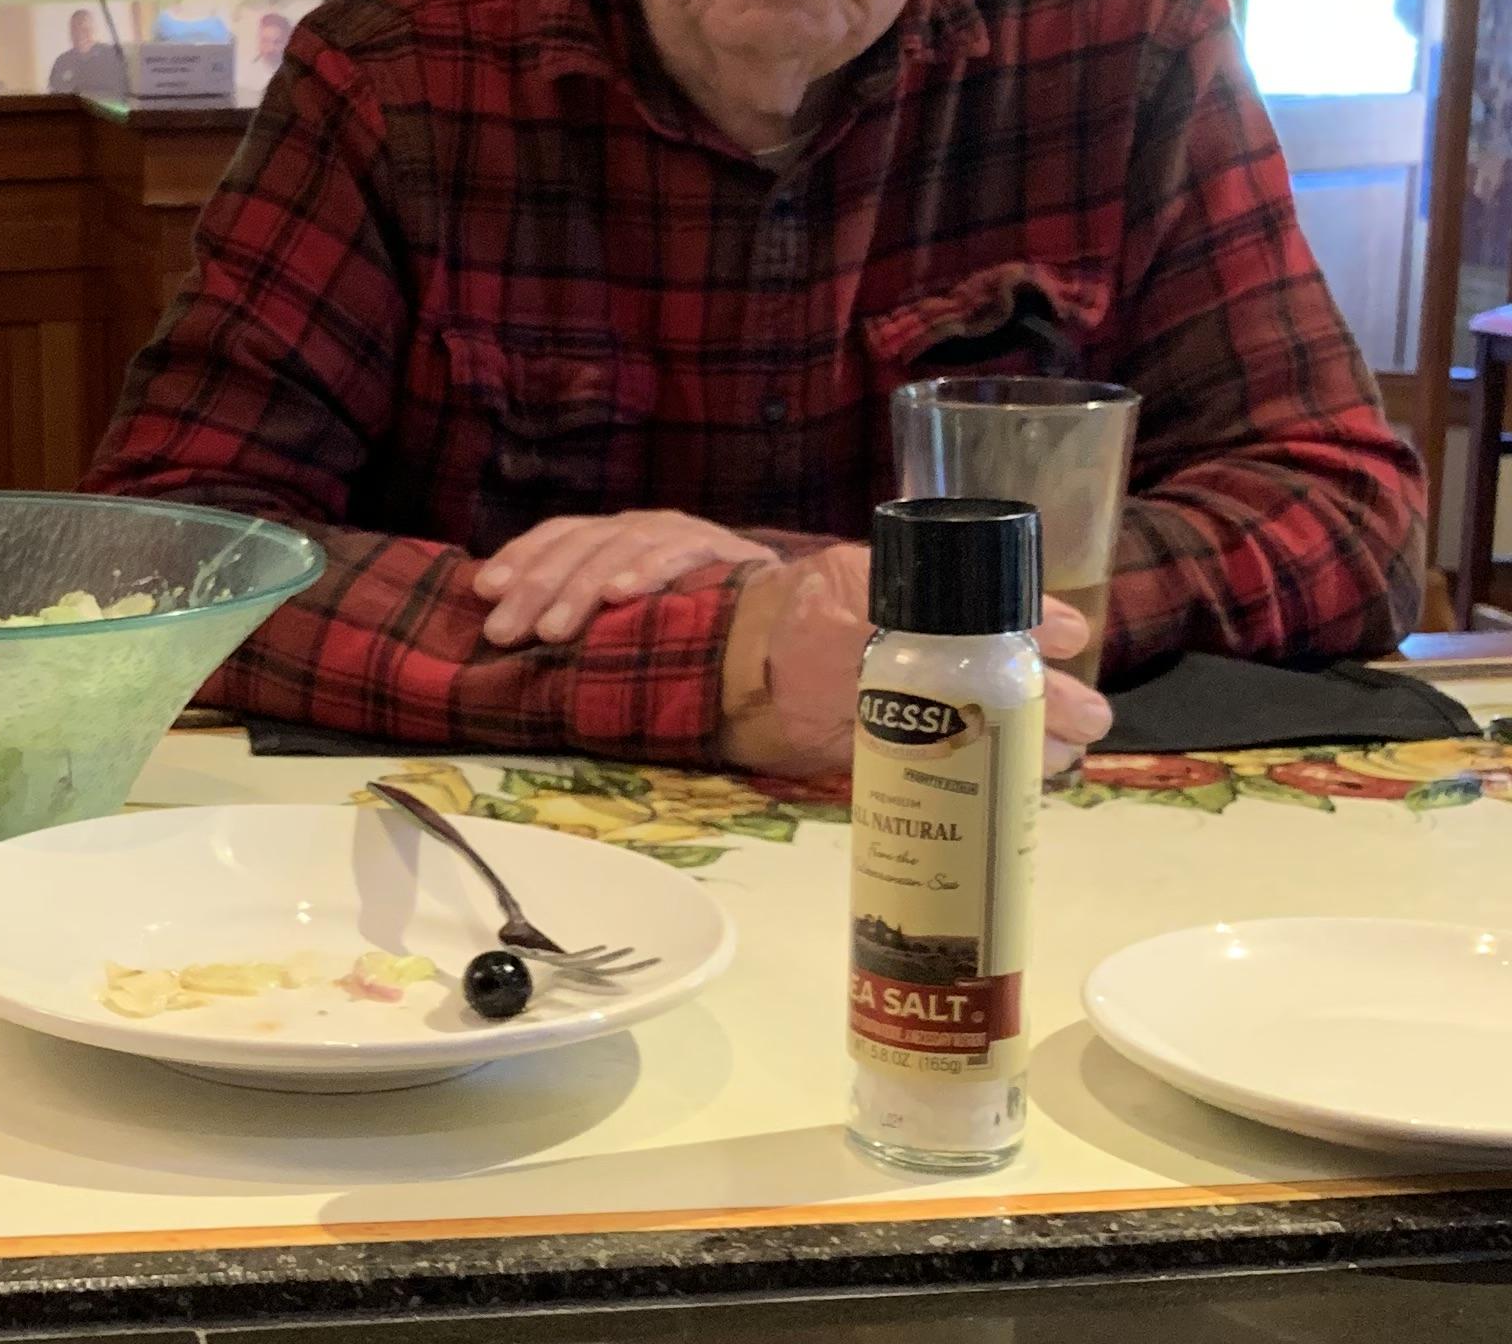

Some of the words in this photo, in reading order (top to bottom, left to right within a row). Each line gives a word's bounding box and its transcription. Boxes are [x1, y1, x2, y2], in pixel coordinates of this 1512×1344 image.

[860, 695, 952, 734] ALESSI
[872, 811, 962, 841] NATURAL
[883, 988, 968, 1022] SALT
